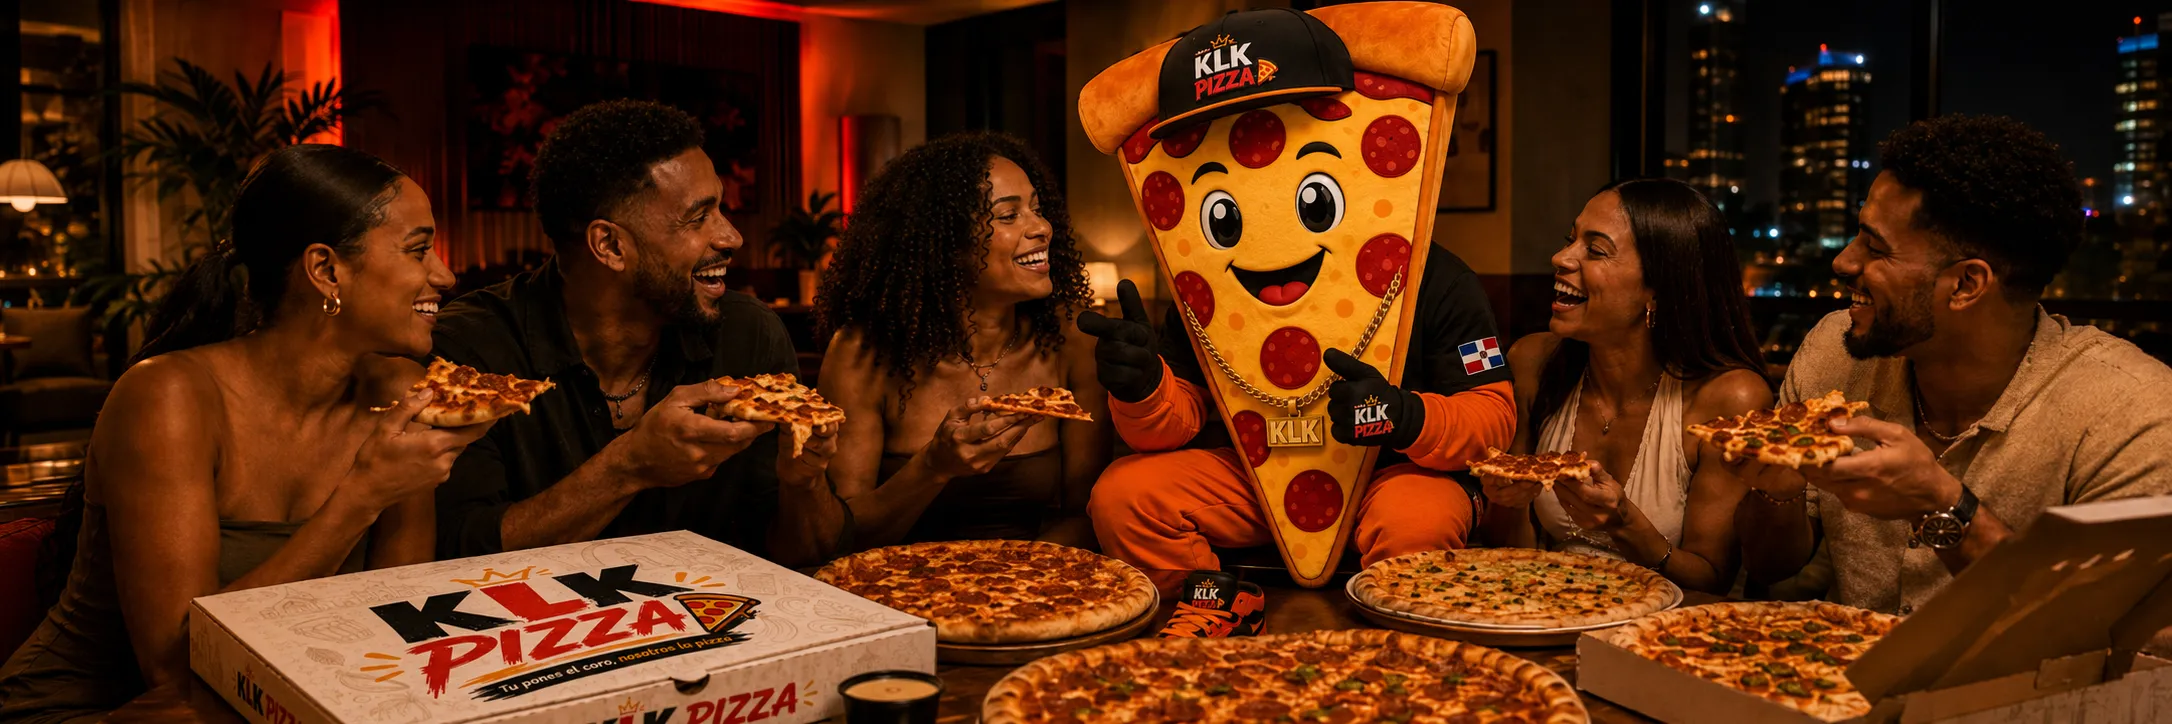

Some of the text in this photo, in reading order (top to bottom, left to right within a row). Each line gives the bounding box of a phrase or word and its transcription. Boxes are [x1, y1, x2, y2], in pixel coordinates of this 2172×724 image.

[1195, 42, 1253, 79] KLK
[1194, 67, 1255, 101] PIZZA
[1270, 419, 1320, 444] KLK
[1354, 404, 1389, 425] KLK
[1354, 420, 1392, 438] PIZZA
[369, 563, 695, 643] KLK
[1193, 588, 1220, 600] KLK
[406, 599, 688, 699] PIZZA
[499, 683, 519, 693] Tu
[521, 671, 564, 689] pones
[566, 665, 581, 675] el
[618, 645, 676, 662] nosotros
[676, 641, 693, 650] la
[695, 636, 733, 649] pizza
[238, 671, 264, 717] KLK
